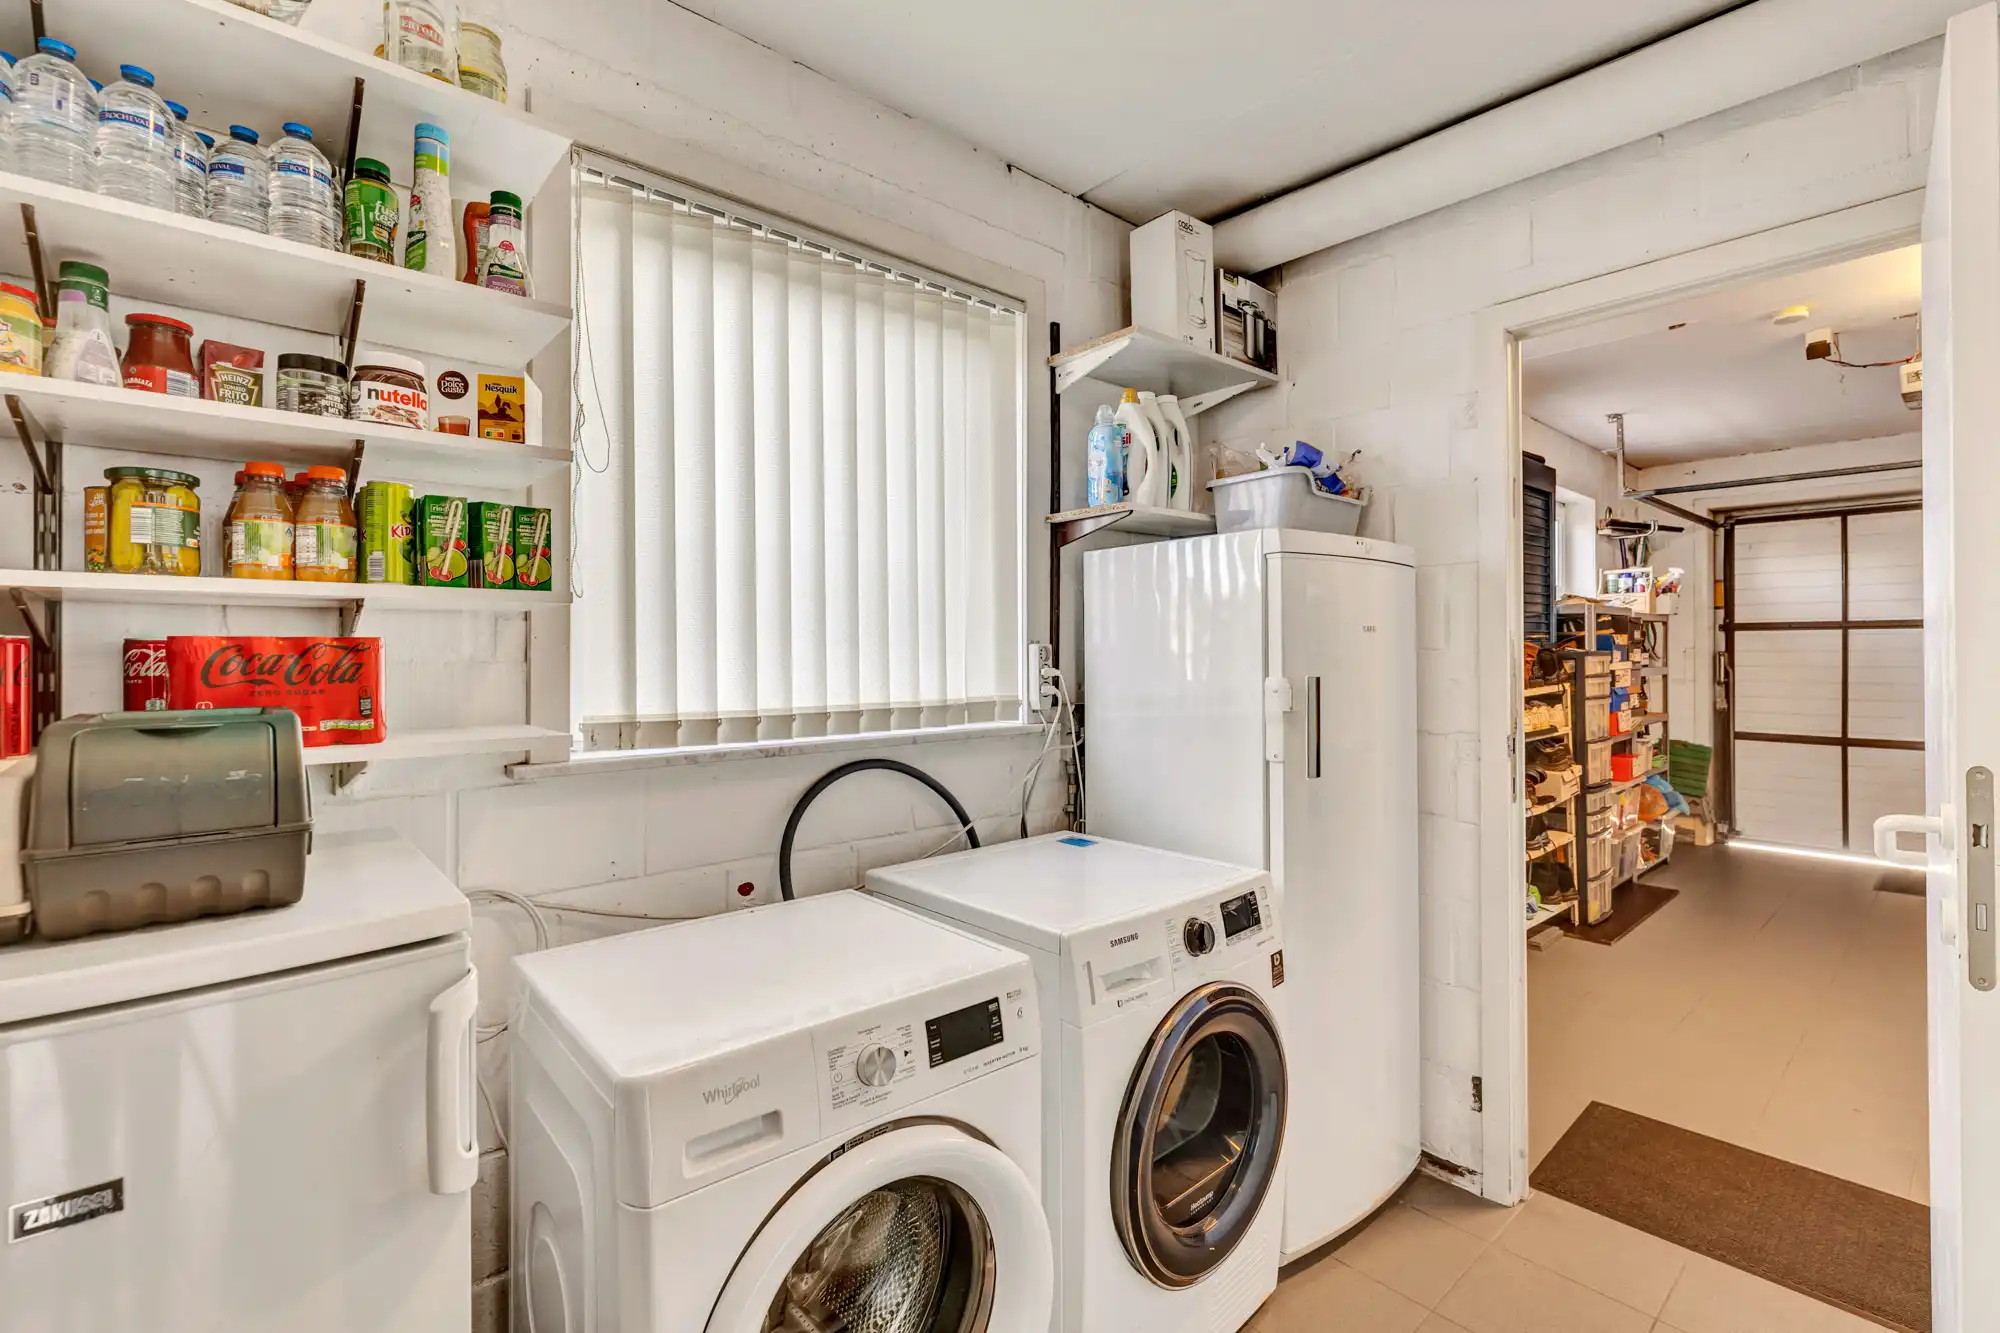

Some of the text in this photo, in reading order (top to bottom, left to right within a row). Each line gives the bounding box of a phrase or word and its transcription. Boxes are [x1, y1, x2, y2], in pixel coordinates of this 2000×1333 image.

[220, 374, 250, 386] HEINZ
[441, 380, 464, 389] Dolce
[223, 383, 246, 393] TOMATO
[441, 386, 465, 394] Gusto
[485, 383, 517, 394] Nesquik
[219, 388, 249, 401] FRITO
[367, 387, 428, 411] nutella
[201, 642, 372, 689] Coca-Cola
[249, 688, 325, 697] ZERO SUGAR
[1109, 932, 1139, 948] SAMSUNG
[702, 1073, 761, 1105] Whirlpool
